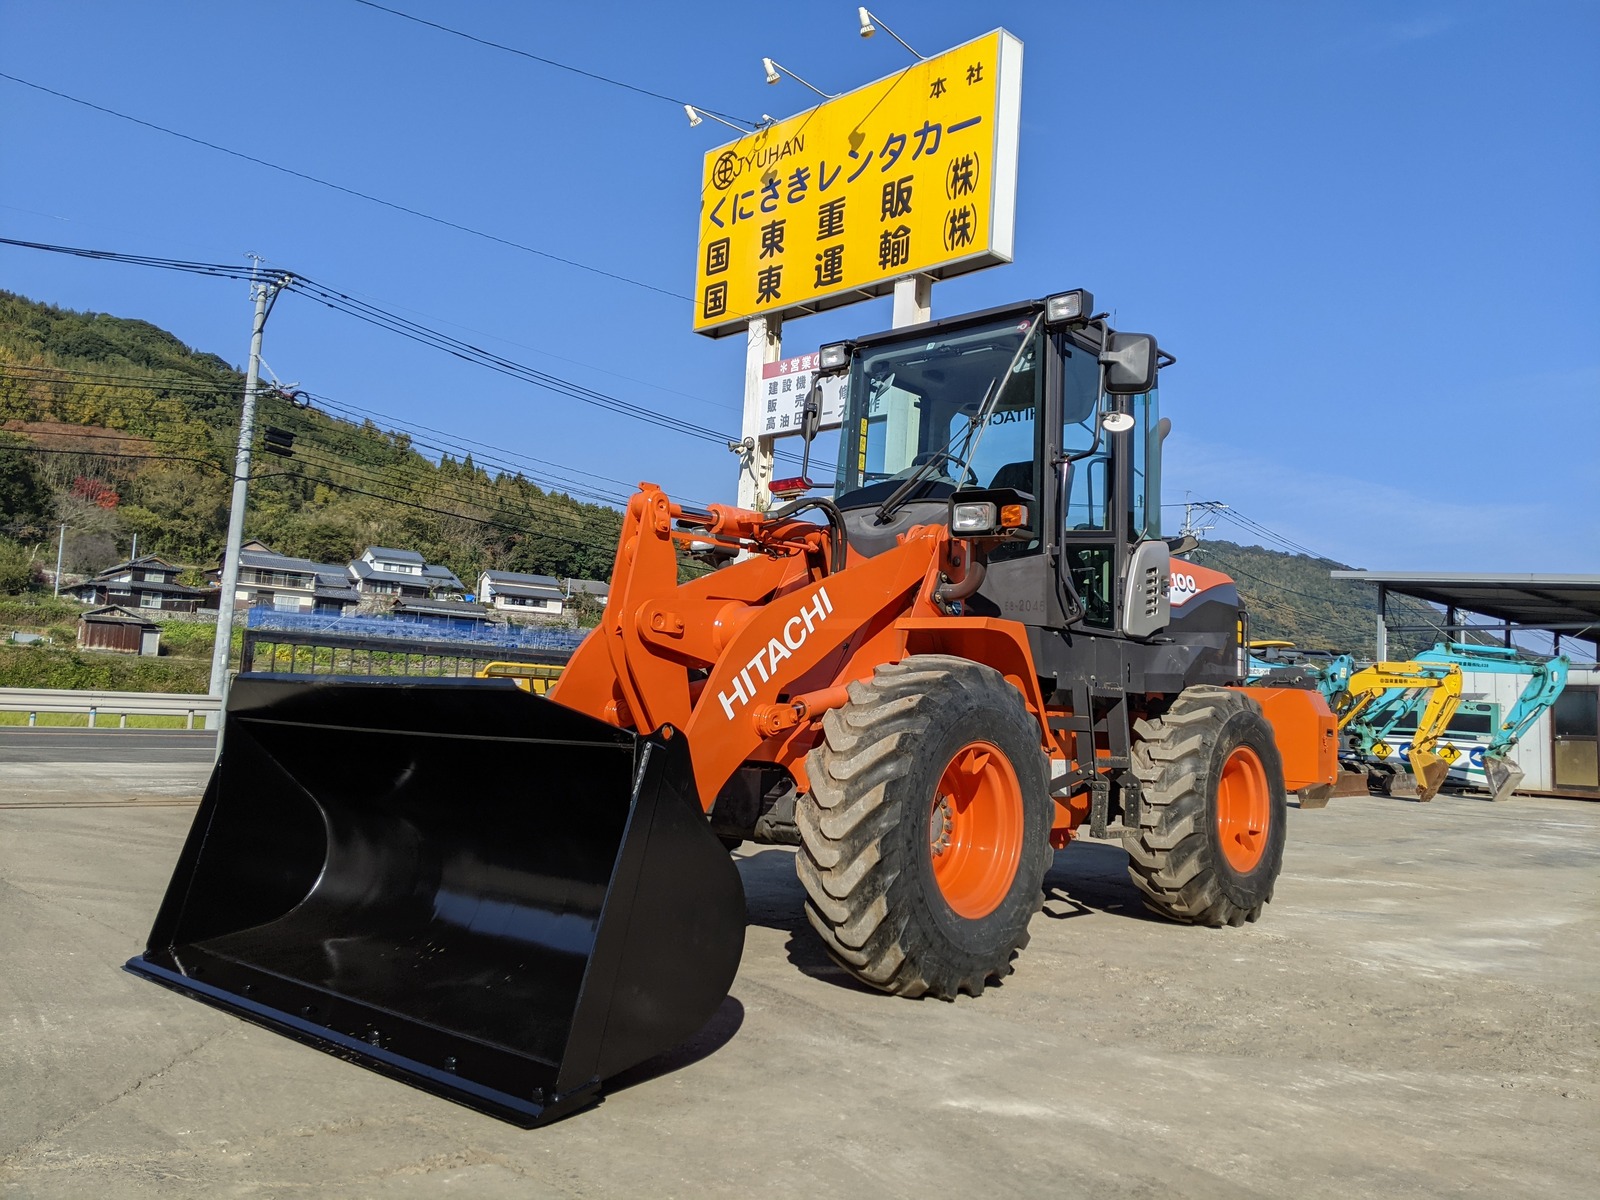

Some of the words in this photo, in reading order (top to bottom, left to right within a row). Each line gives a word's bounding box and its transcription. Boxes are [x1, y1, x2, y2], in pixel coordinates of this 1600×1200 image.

[929, 63, 984, 99] 本社
[709, 115, 983, 228] くにさきレンタカー
[732, 134, 805, 177] JYUHAN
[717, 586, 833, 720] HITACHI
